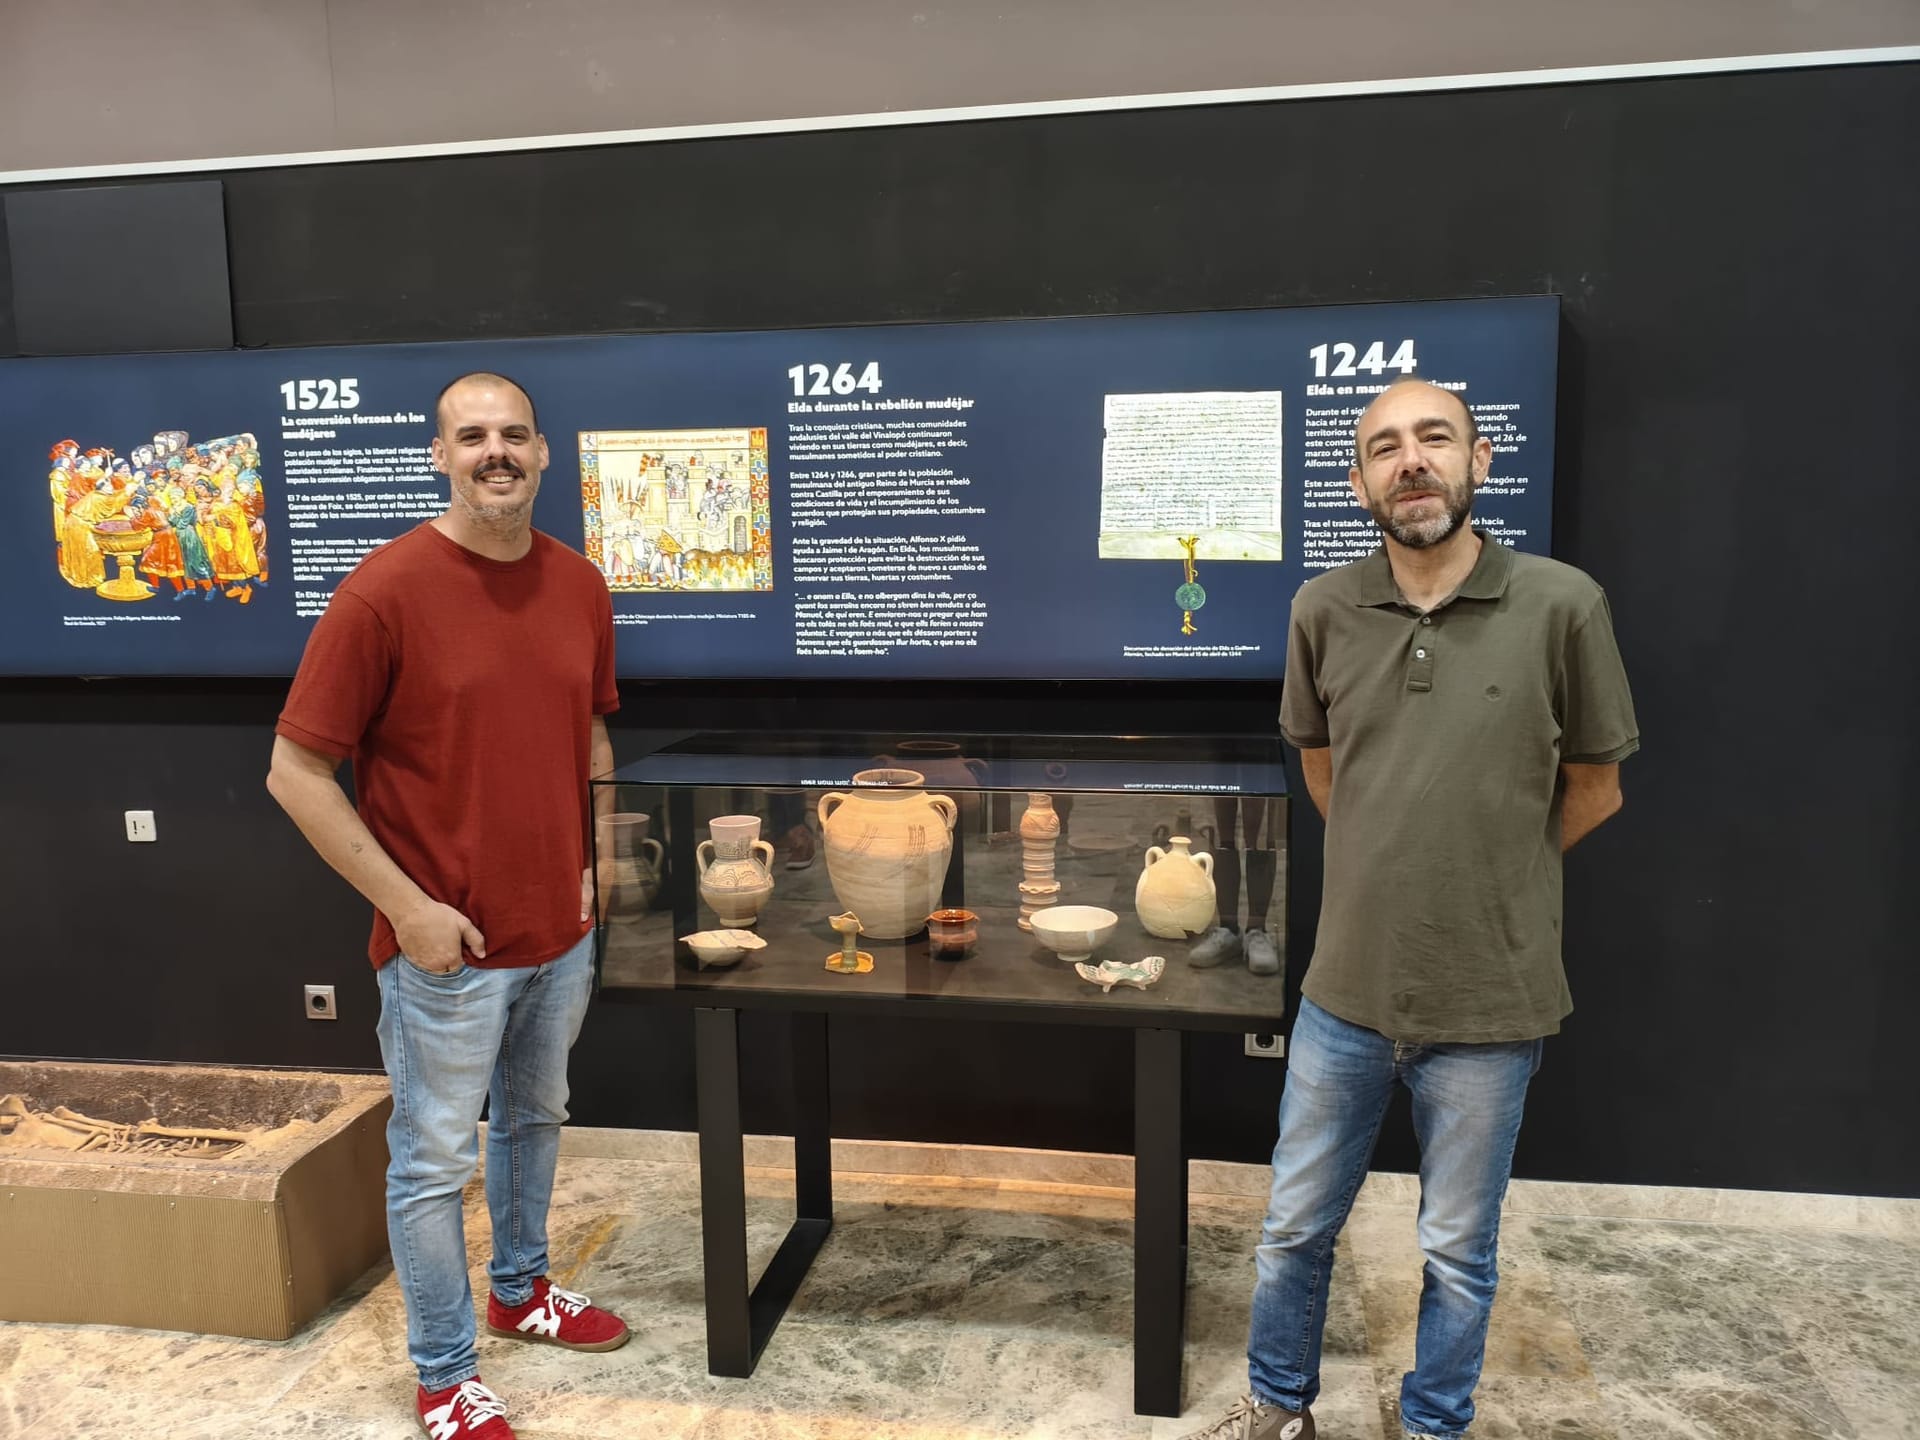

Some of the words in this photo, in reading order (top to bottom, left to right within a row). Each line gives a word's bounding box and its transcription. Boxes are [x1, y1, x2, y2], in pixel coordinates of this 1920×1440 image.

[1310, 339, 1417, 377] 1244
[788, 361, 882, 396] 1264
[280, 378, 360, 410] 1525
[1307, 384, 1334, 395] Elda
[1336, 386, 1353, 394] en
[787, 401, 812, 413] Elda
[814, 400, 859, 412] durante
[861, 400, 872, 410] la
[874, 398, 923, 410] rebelión
[925, 397, 974, 412] mudéjar
[1306, 408, 1339, 416] Durante
[1340, 407, 1348, 415] el
[1350, 407, 1365, 417] sigl
[282, 415, 294, 426] La
[295, 414, 351, 426] conversión
[352, 413, 392, 424] forzosa
[393, 412, 407, 423] de
[408, 412, 425, 423] los
[1305, 418, 1327, 426] hacia
[1328, 418, 1336, 426] el
[789, 423, 804, 431] Tras
[805, 423, 812, 431] la
[813, 422, 849, 432] conquista
[850, 421, 884, 430] cristiana,
[885, 421, 915, 429] muchas
[916, 419, 966, 428] comunidades
[1305, 428, 1348, 436] territorios
[1505, 423, 1516, 431] En
[283, 427, 336, 441] mudéjares
[828, 432, 840, 440] del
[859, 431, 871, 439] del
[873, 430, 905, 440] Vinalopó
[907, 429, 952, 438] continuaron
[789, 442, 820, 450] viviendo
[846, 441, 870, 449] tierras
[894, 440, 935, 450] mudéjares,
[947, 439, 968, 448] decir,
[1324, 438, 1356, 446] context
[1493, 434, 1501, 442] el
[1502, 434, 1514, 442] 26
[789, 451, 835, 460] musulmanes
[877, 450, 883, 458] al
[885, 450, 906, 459] poder
[908, 449, 943, 457] cristiano.
[1331, 448, 1343, 456] de
[1305, 459, 1336, 467] Alfonso
[790, 470, 809, 478] Entre
[811, 470, 829, 478] 1264
[837, 470, 856, 478] 1266,
[858, 471, 875, 479] gran
[876, 469, 896, 478] parte
[908, 468, 915, 476] la
[916, 468, 953, 478] población
[790, 480, 832, 488] musulmana
[846, 479, 874, 489] antiguo
[898, 478, 908, 486] de
[909, 478, 934, 486] Murcia
[946, 477, 970, 485] rebeló
[1304, 479, 1322, 487] Este
[1484, 476, 1515, 486] Aragón
[791, 490, 814, 498] contra
[815, 489, 842, 497] Castilla
[865, 488, 924, 498] empeoramiento
[1313, 489, 1344, 497] sureste
[1510, 488, 1525, 496] por
[791, 499, 834, 507] condiciones
[846, 498, 862, 506] vida
[863, 500, 868, 508] y
[869, 498, 876, 506] el
[877, 497, 935, 507] incumplimiento
[825, 510, 839, 518] que
[891, 507, 939, 517] propiedades,
[941, 506, 985, 514] costumbres
[792, 520, 796, 528] y
[1322, 519, 1330, 527] el
[1332, 519, 1364, 528] tratado,
[1481, 517, 1504, 525] hacia
[1332, 531, 1338, 539] y
[1339, 529, 1374, 537] sometió
[819, 536, 852, 546] gravedad
[853, 536, 863, 544] de
[864, 536, 871, 544] la
[872, 536, 908, 544] situación,
[909, 535, 938, 543] Alfonso
[940, 535, 945, 543] X
[946, 535, 966, 544] pidió
[1317, 539, 1343, 547] Medio
[1345, 539, 1382, 548] Vinalopó
[1304, 549, 1326, 558] 1244,
[1328, 549, 1367, 557] concedió
